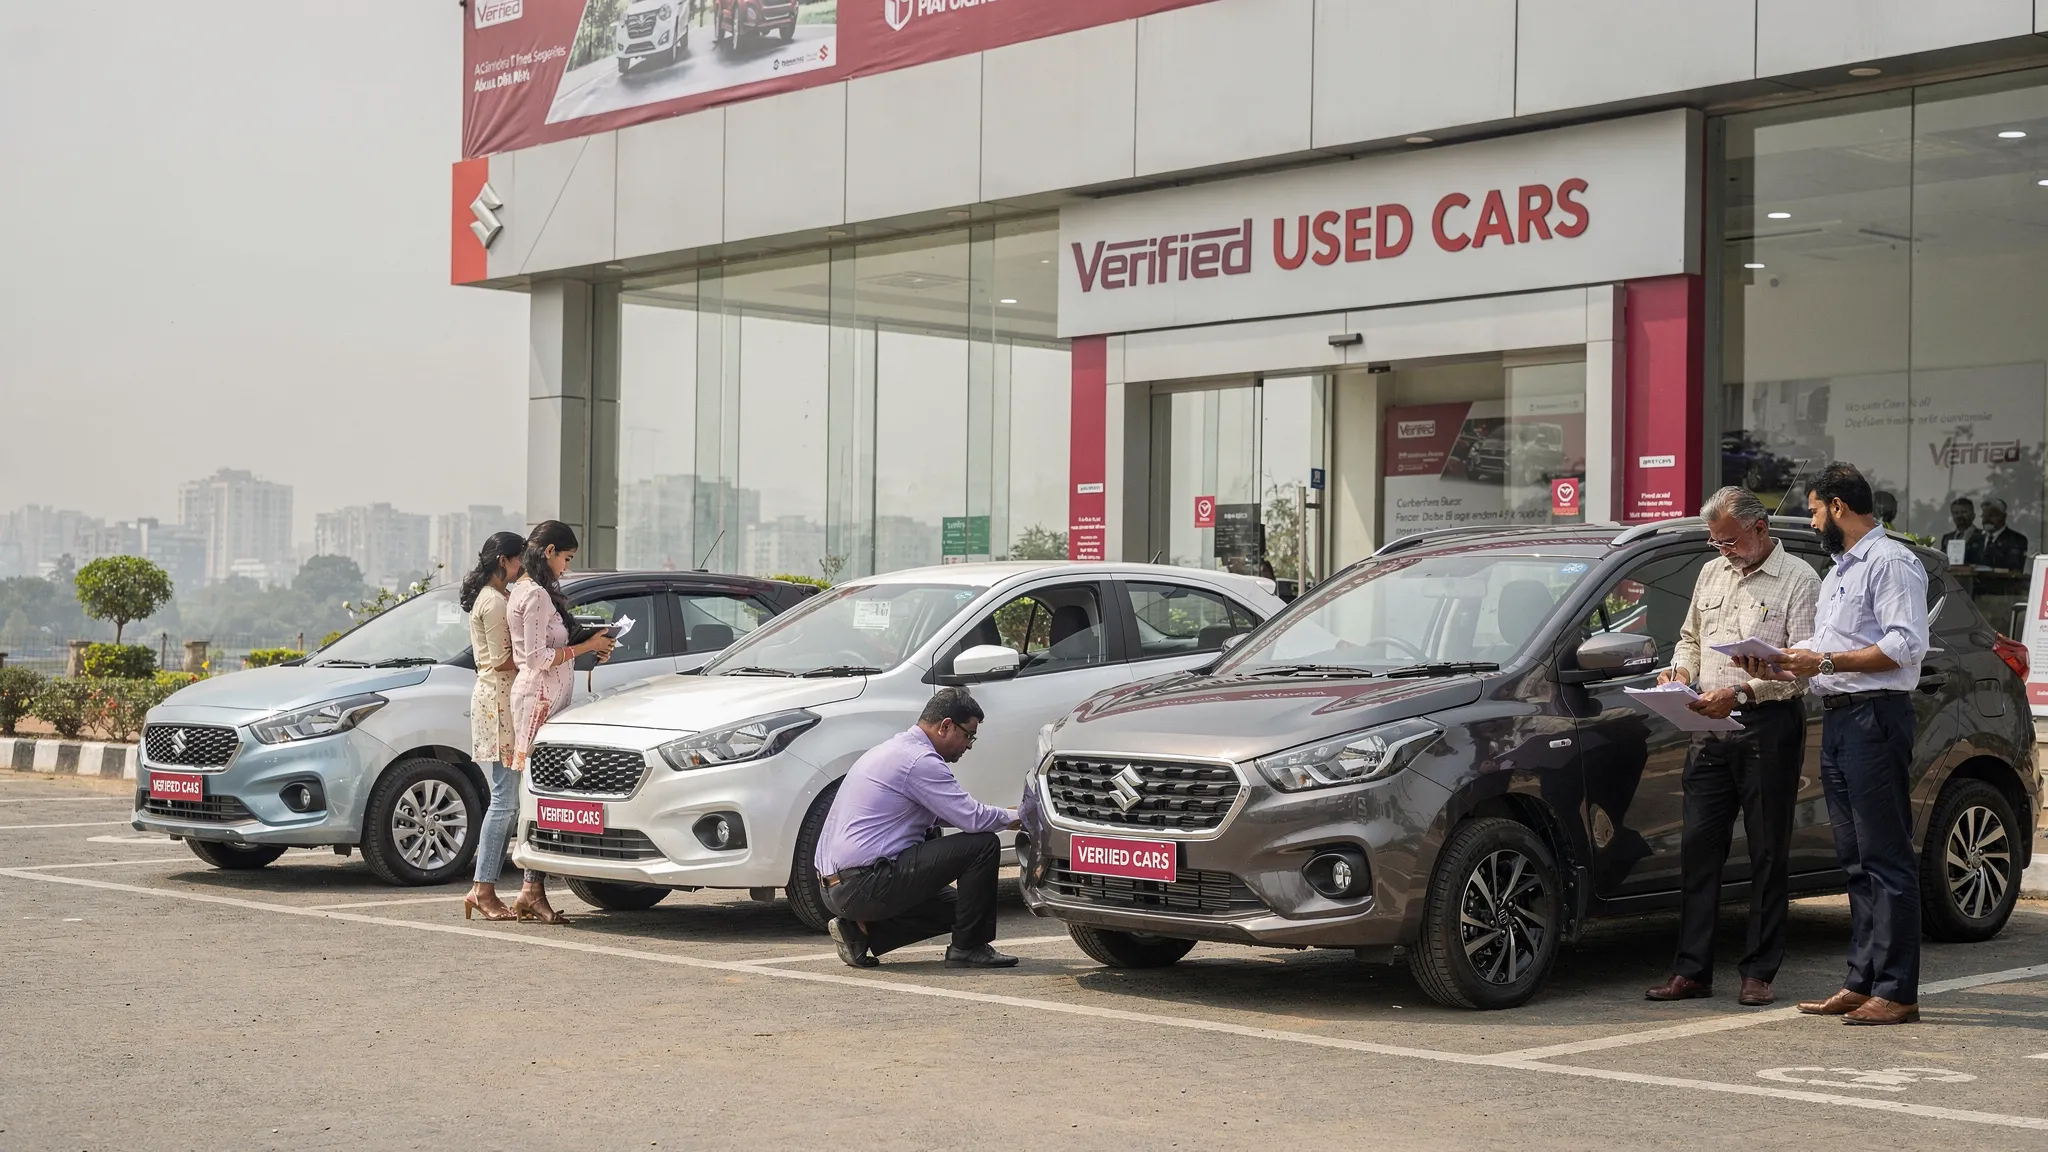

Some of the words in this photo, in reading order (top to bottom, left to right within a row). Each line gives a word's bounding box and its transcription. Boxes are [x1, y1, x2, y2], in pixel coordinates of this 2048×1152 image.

[1071, 218, 1252, 292] Verified
[1273, 203, 1413, 270] USED
[1432, 177, 1589, 252] CARS
[577, 810, 600, 825] CARS
[1133, 851, 1169, 869] CARS
